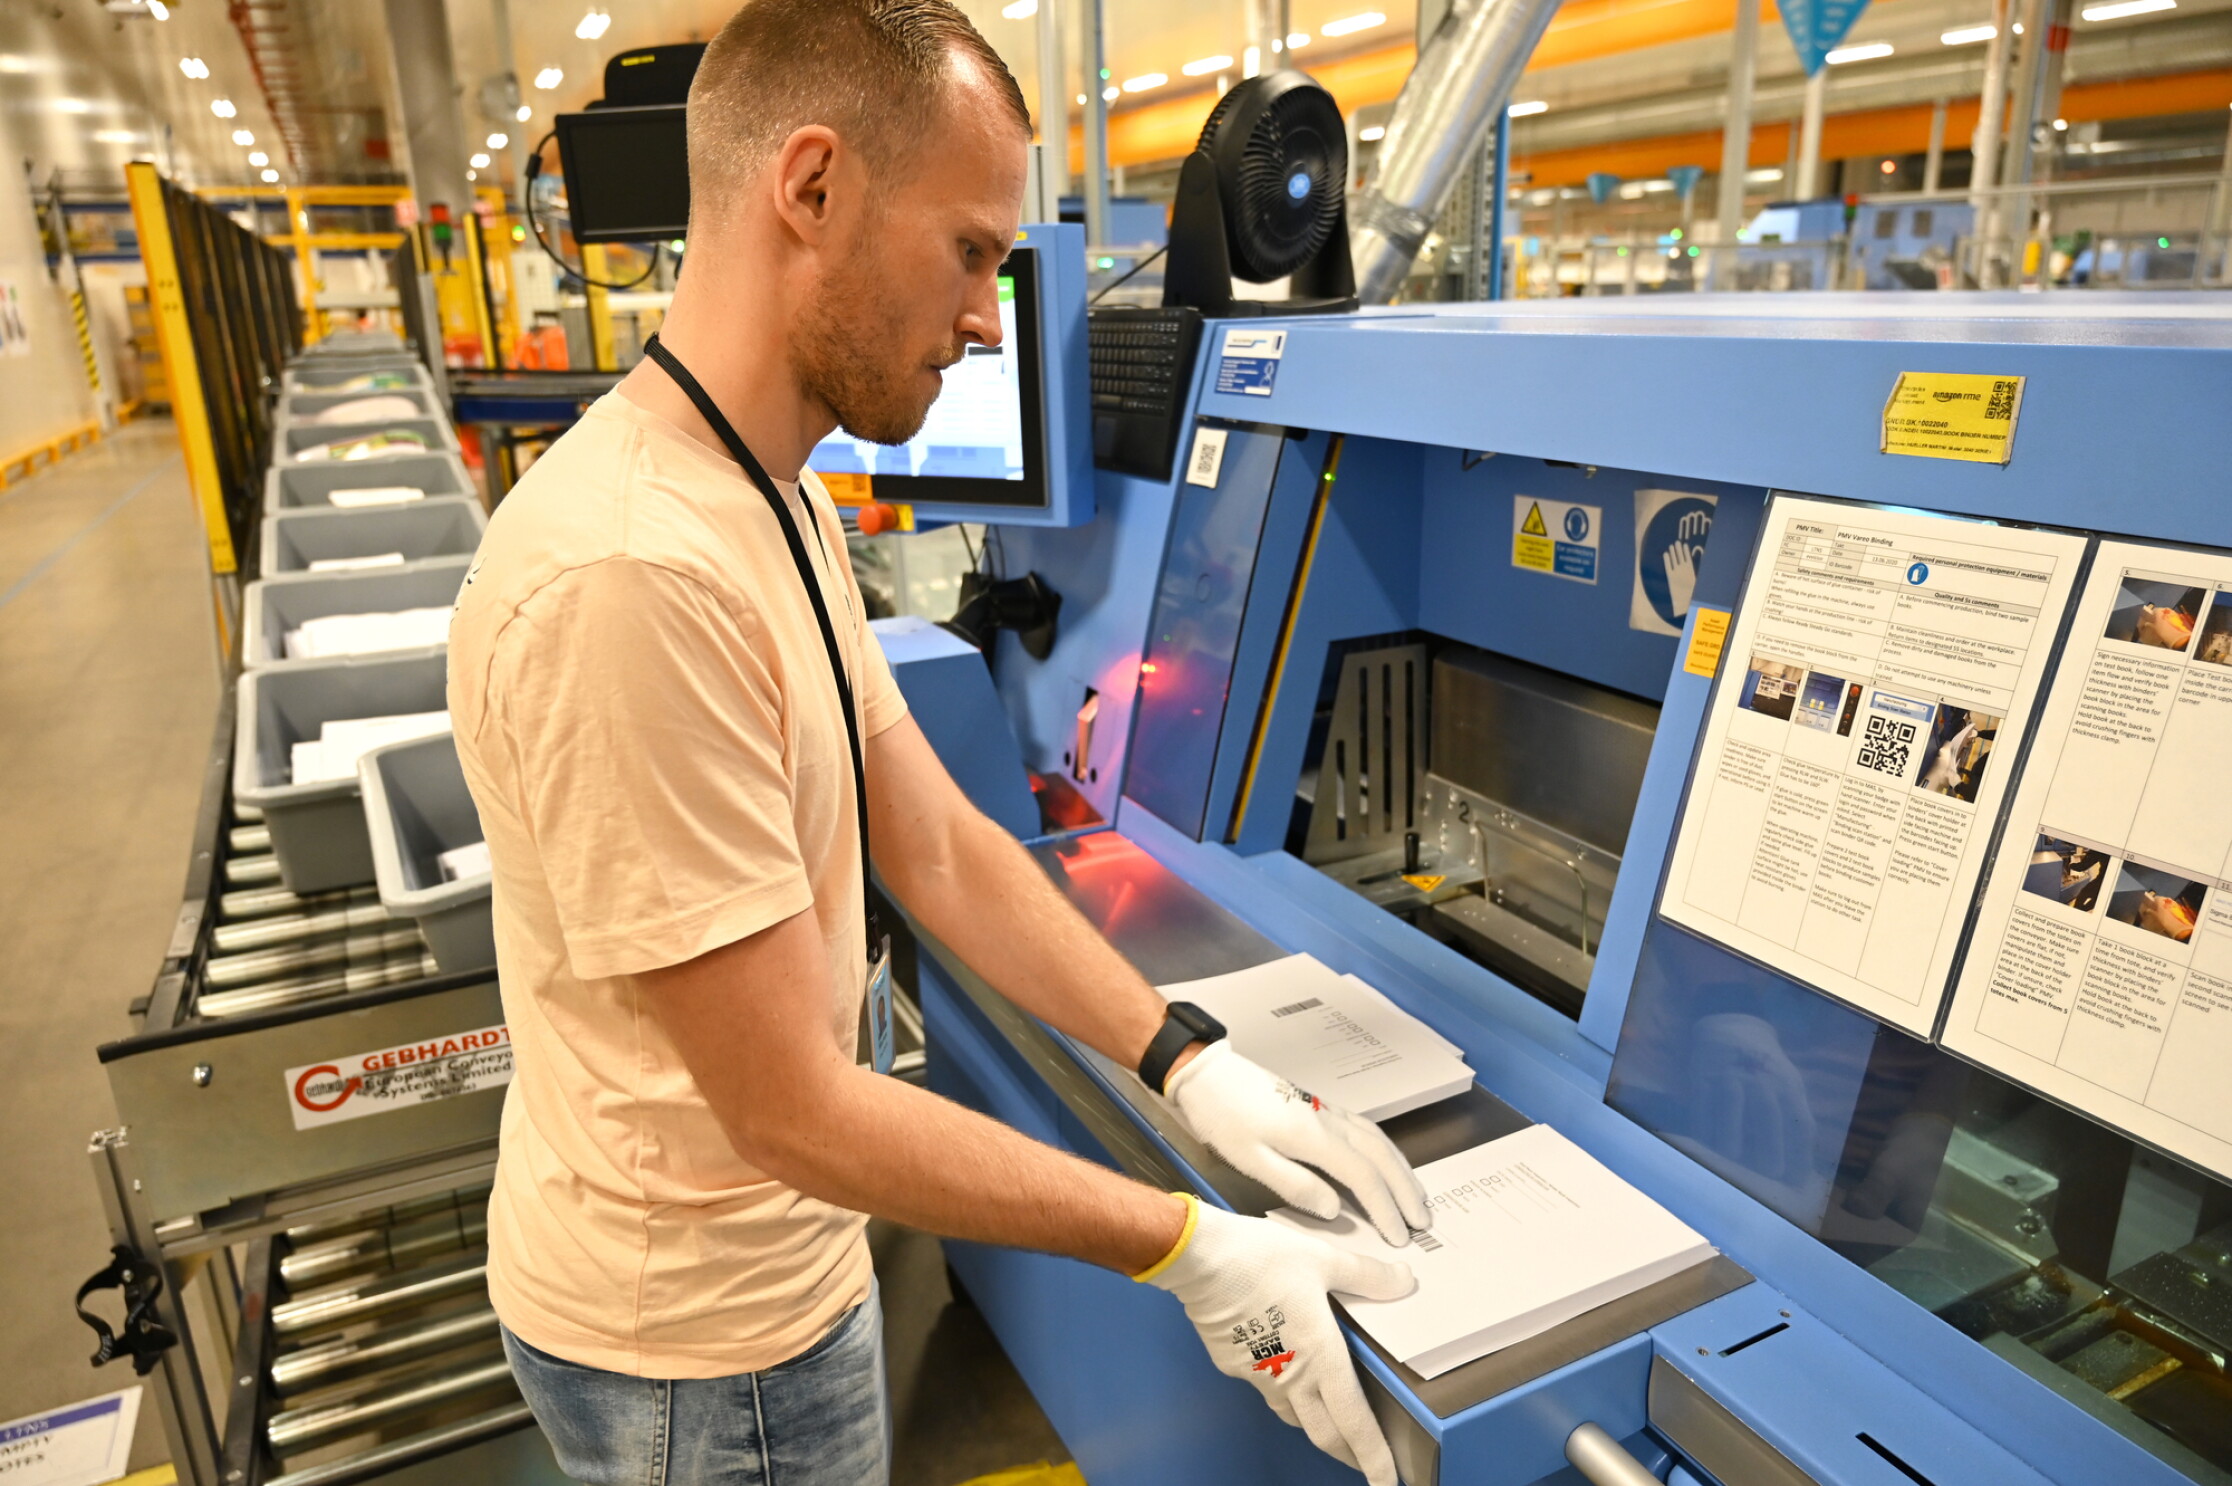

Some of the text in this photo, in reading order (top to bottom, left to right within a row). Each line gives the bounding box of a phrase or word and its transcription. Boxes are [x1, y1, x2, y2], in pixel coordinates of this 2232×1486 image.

[1932, 391, 1962, 401] amazon
[1962, 393, 1982, 401] rme
[1810, 526, 1824, 534] Title:
[1837, 531, 1893, 547] PMV Vareo Binding
[1912, 554, 1935, 563] Required
[1934, 558, 1958, 566] personal
[1956, 562, 1985, 571] protection
[1985, 566, 2016, 576] equipment
[2020, 572, 2047, 581] materials
[1934, 592, 1953, 602] Quality
[1971, 599, 1999, 609] comments
[2096, 651, 2180, 672] Sign necessary information
[2116, 664, 2133, 674] book,
[2134, 667, 2155, 677] follow
[2088, 677, 2116, 688] thickness
[2106, 671, 2120, 679] flow
[2134, 678, 2152, 686] verify
[2152, 681, 2169, 690] book
[2082, 693, 2098, 702] book
[2098, 697, 2116, 706] block
[2123, 702, 2135, 710] the
[2135, 706, 2150, 714] area
[2150, 708, 2161, 716] for
[2086, 686, 2110, 695] scanner
[2118, 693, 2142, 704] placing
[2077, 710, 2092, 719] Hold
[2092, 714, 2108, 722] book
[2116, 719, 2128, 727] the
[2127, 722, 2143, 730] back
[2080, 703, 2126, 718] scanning books.
[2071, 727, 2120, 744] thickness clamp.
[2074, 719, 2092, 728] avoid
[2091, 724, 2118, 735] crushing
[2118, 728, 2140, 739] fingers
[2011, 917, 2030, 928] covers
[2030, 922, 2045, 932] from
[2046, 929, 2056, 937] the
[2056, 932, 2072, 943] totes
[2014, 908, 2085, 938] Collect and prepare book
[2006, 932, 2025, 943] covers
[2036, 942, 2047, 952] flat,
[2054, 950, 2066, 959] not,
[2009, 924, 2079, 954] the conveyor. Make sure
[2001, 948, 2017, 958] place
[2024, 956, 2035, 965] the
[2034, 961, 2051, 970] cover
[2051, 967, 2071, 978] holder
[2004, 940, 2065, 967] manipulate them and
[1997, 963, 2016, 975] binder.
[2022, 975, 2044, 987] unsure,
[2044, 983, 2062, 994] check
[1999, 956, 2012, 965] area
[2019, 964, 2030, 972] the
[2030, 967, 2044, 977] back
[2052, 976, 2062, 985] the
[1990, 987, 2018, 1003] totes max.
[1992, 979, 2012, 991] Collect
[2012, 987, 2027, 997] book
[2027, 994, 2047, 1006] covers
[2047, 1001, 2063, 1012] from
[2038, 988, 2054, 999] PMV.
[362, 1027, 511, 1071] GEBHARDT
[364, 1050, 513, 1091] European Conveyo
[452, 1063, 511, 1083] Limited
[1250, 1341, 1286, 1361] MCR
